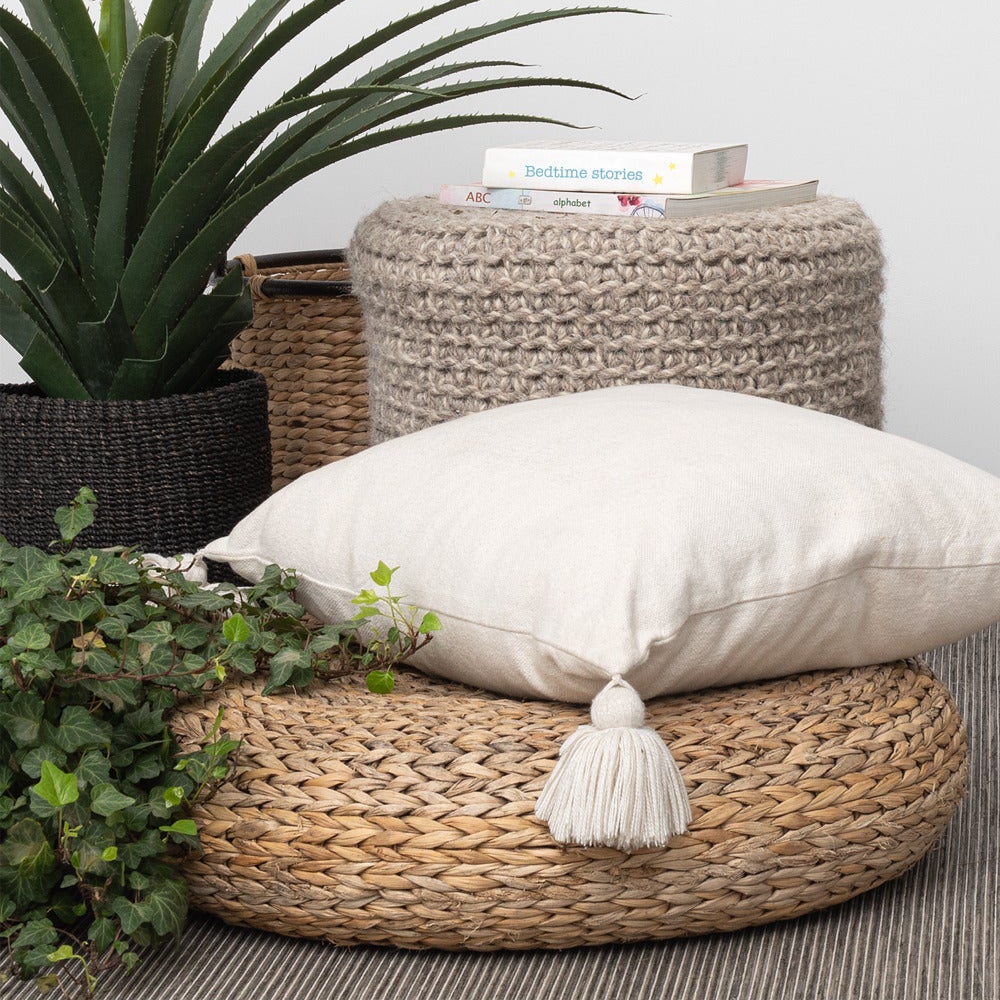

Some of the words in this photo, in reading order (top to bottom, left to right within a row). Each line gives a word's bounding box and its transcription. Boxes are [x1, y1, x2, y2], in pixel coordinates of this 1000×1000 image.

[524, 165, 588, 180] Bedtime
[591, 167, 643, 181] stories
[466, 192, 491, 204] ABC
[553, 198, 591, 208] alphabet
